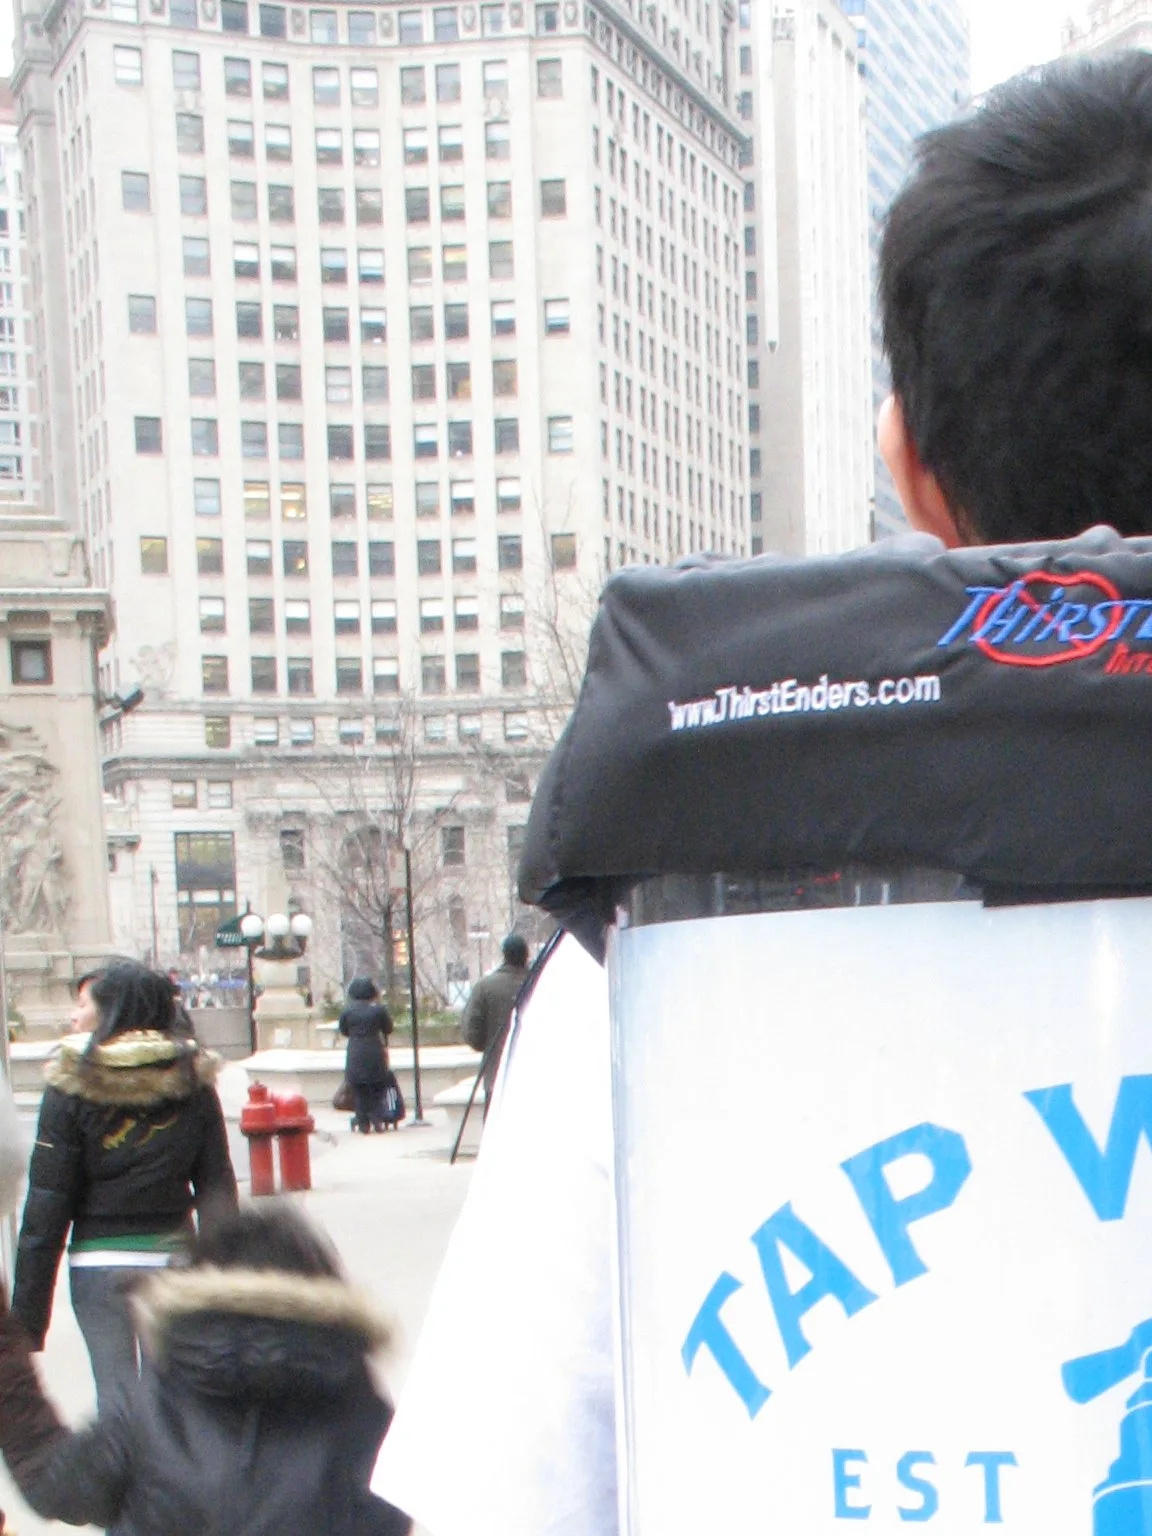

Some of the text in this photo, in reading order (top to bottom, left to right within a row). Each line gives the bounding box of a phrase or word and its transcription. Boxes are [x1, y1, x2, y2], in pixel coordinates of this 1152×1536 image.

[668, 673, 942, 732] www.ThirstEnders.com
[681, 1121, 974, 1421] TAP
[831, 1447, 1019, 1524] EST
